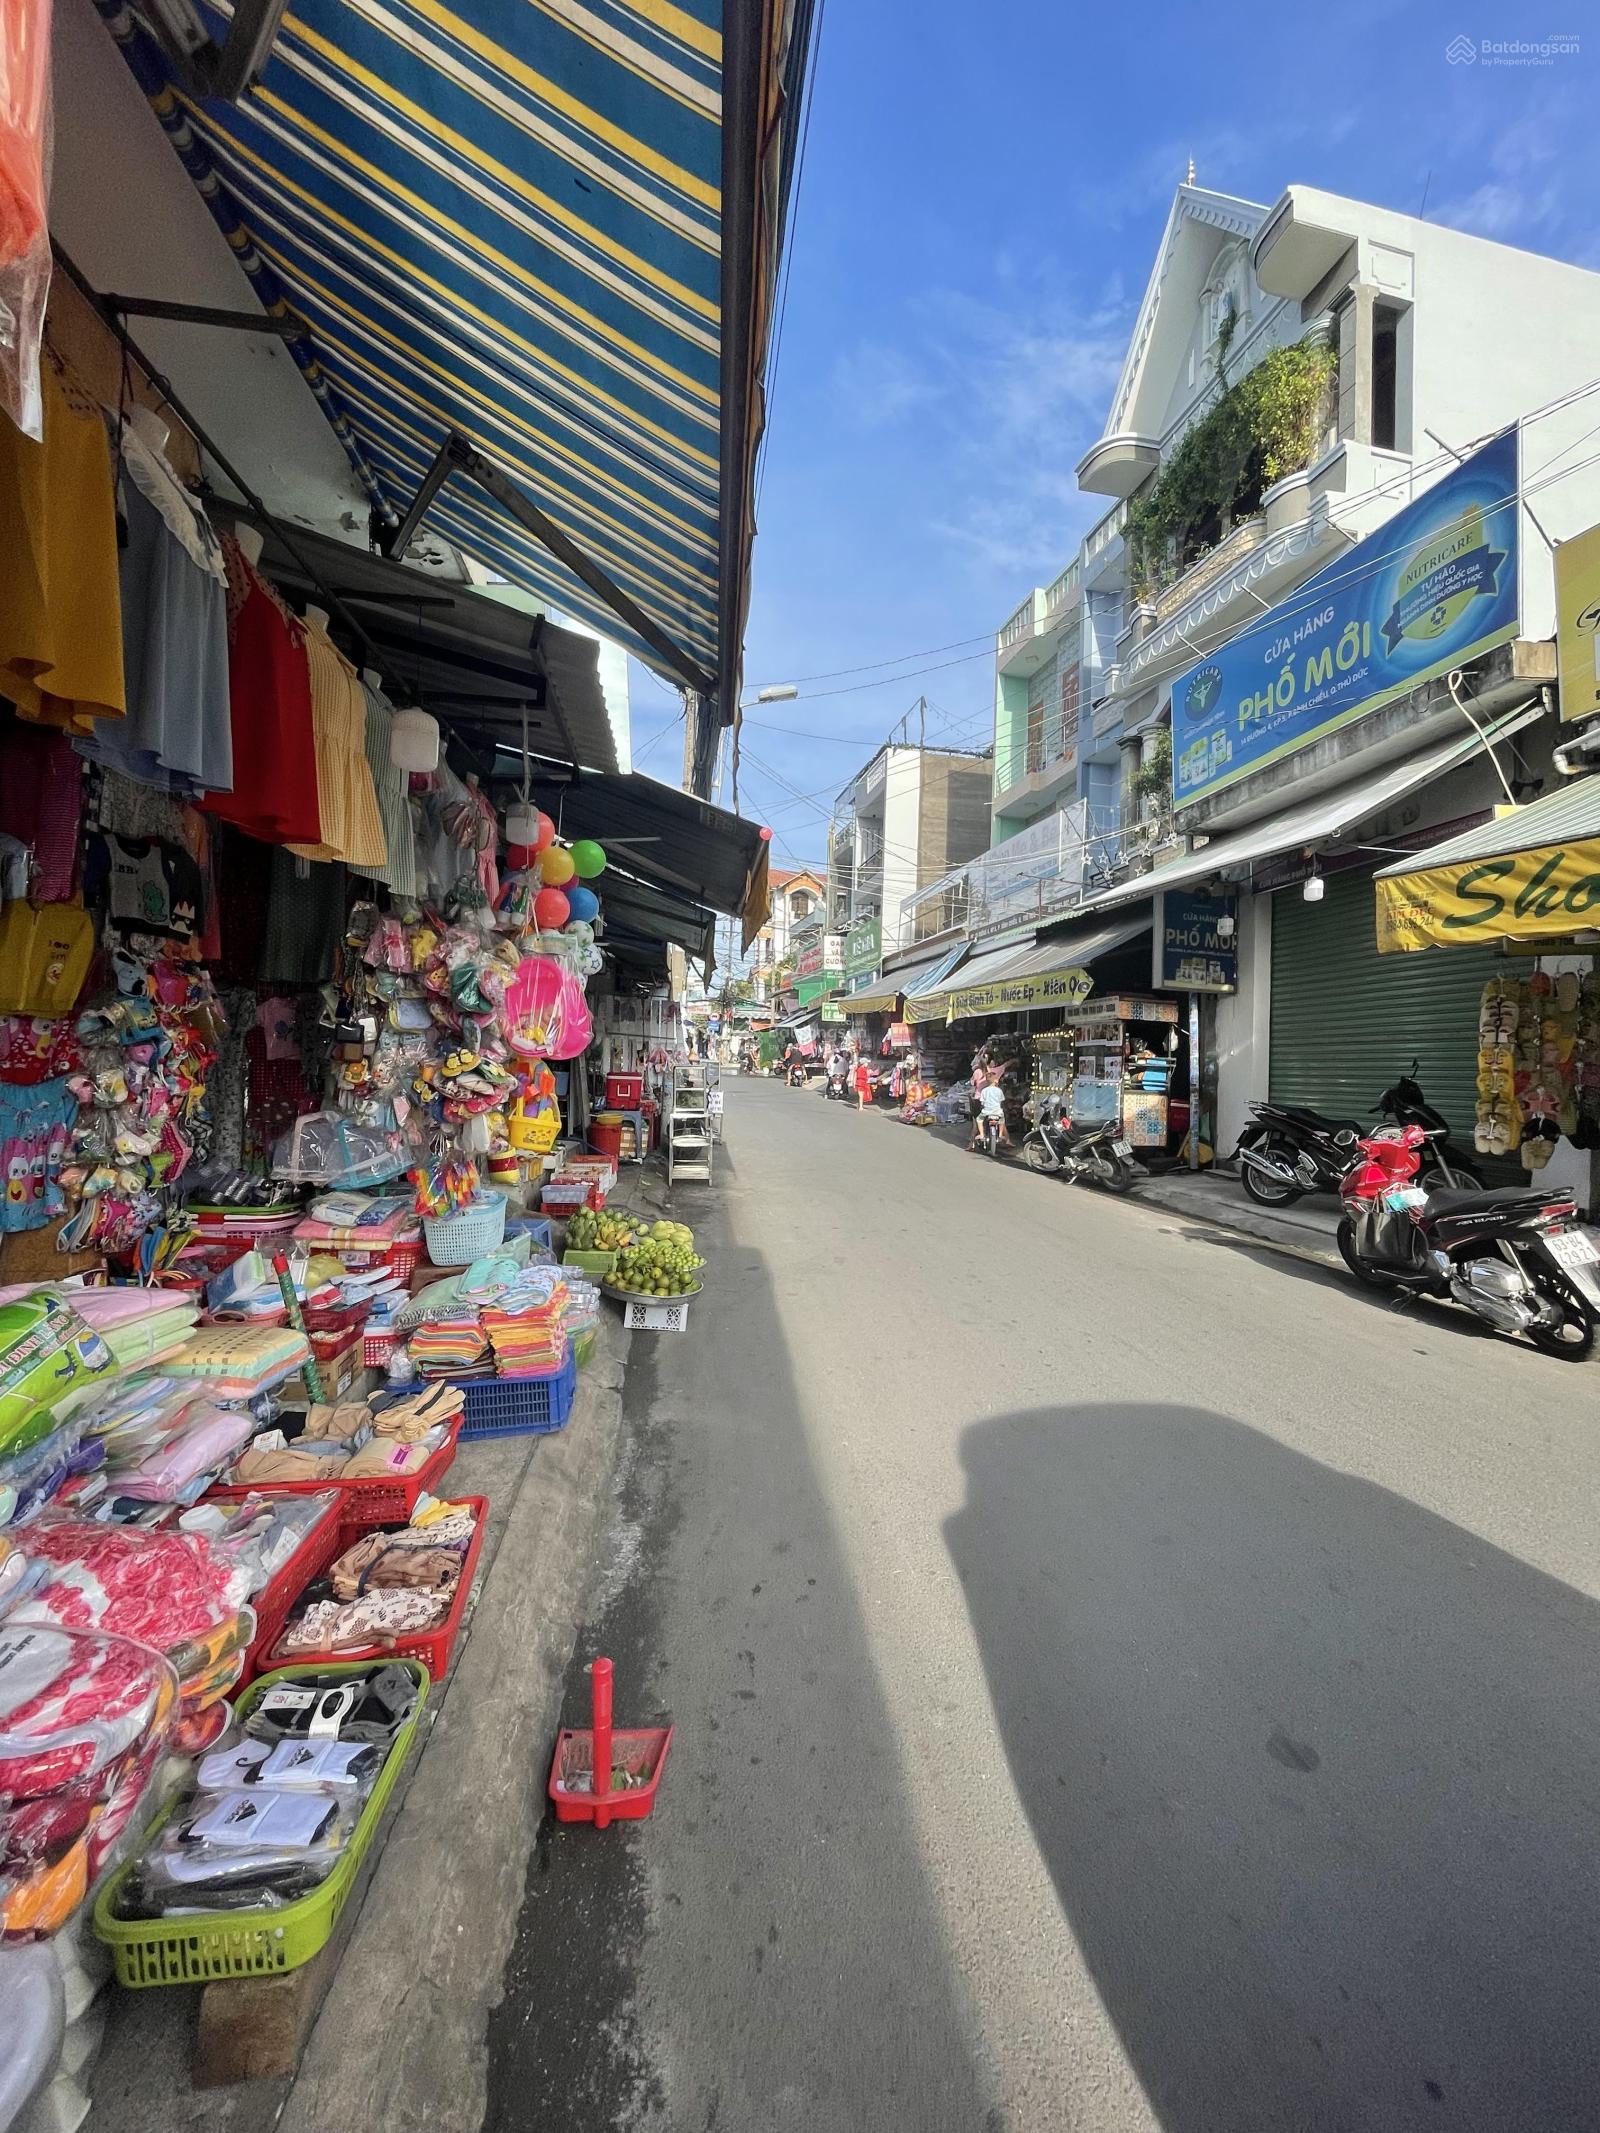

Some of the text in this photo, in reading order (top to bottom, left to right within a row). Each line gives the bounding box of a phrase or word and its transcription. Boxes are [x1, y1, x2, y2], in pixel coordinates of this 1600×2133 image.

[1406, 531, 1473, 585] NUTRICARE
[1434, 564, 1456, 581] HÀO
[1264, 606, 1336, 664] CỬA HÀNG
[1238, 652, 1296, 732] PHỐ
[1304, 620, 1371, 694] MỚI
[1164, 922, 1200, 947] PHỐ
